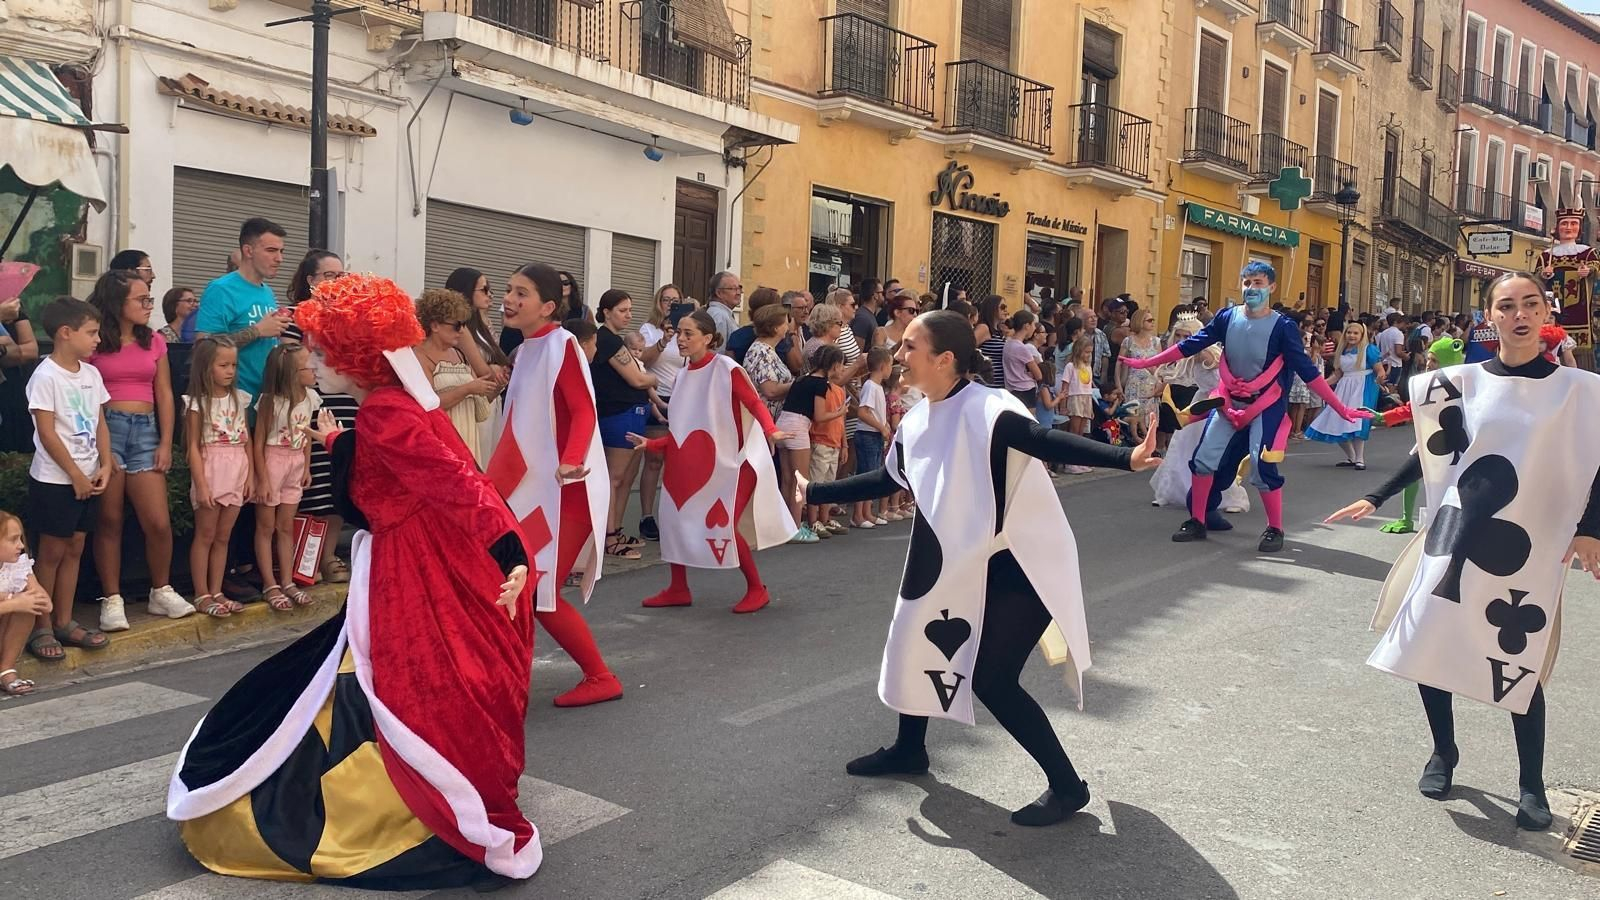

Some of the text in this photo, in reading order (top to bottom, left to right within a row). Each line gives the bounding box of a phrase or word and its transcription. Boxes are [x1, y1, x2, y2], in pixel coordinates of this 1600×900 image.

[1026, 211, 1088, 235] Tienda de Música
[1204, 209, 1288, 241] FARMACIA
[1465, 263, 1496, 277] CAFE-BAR
[1419, 368, 1463, 406] A
[705, 538, 731, 565] A
[924, 670, 966, 712] A
[1486, 656, 1536, 703] A
